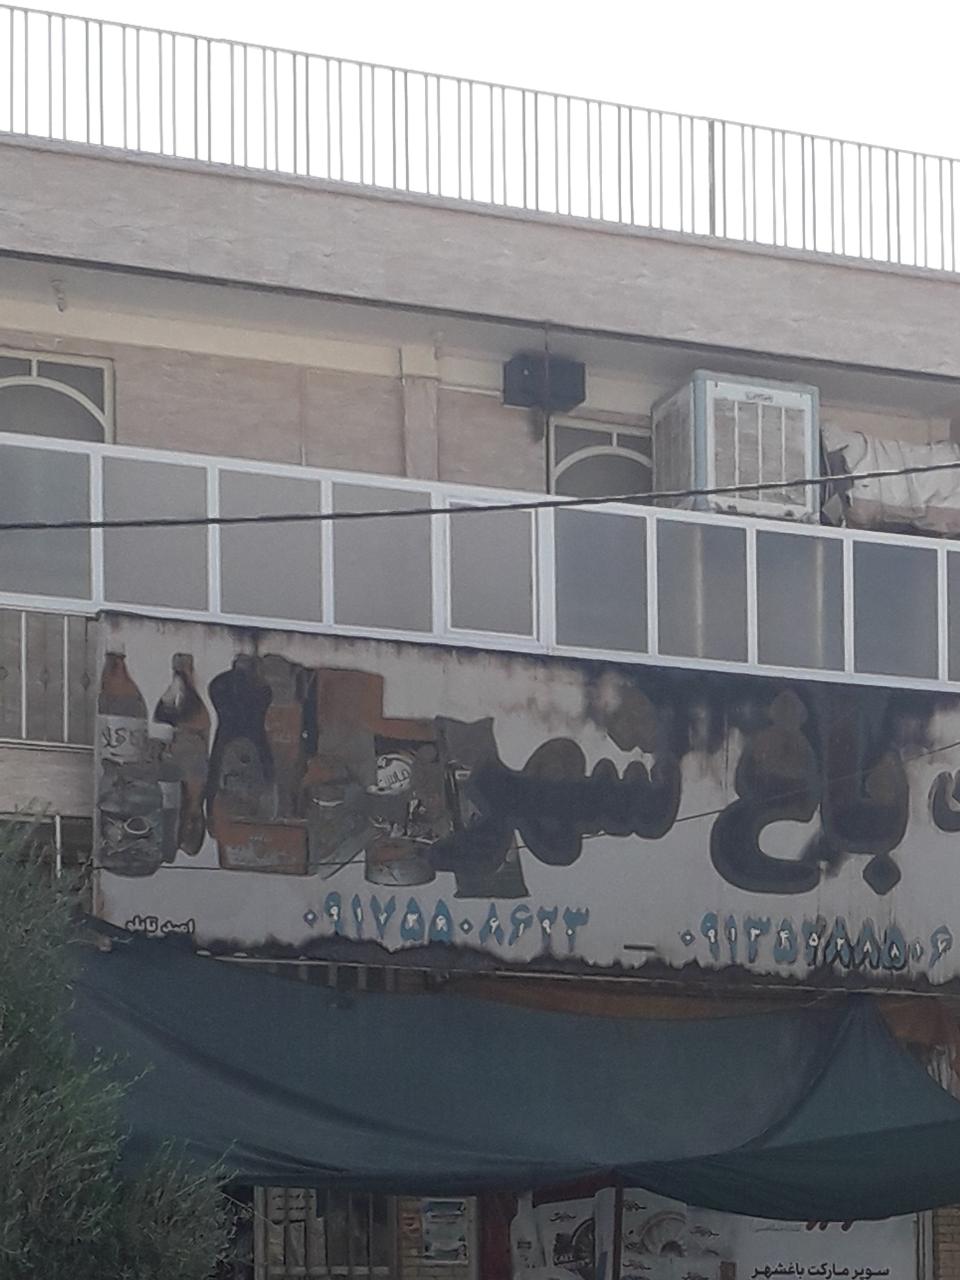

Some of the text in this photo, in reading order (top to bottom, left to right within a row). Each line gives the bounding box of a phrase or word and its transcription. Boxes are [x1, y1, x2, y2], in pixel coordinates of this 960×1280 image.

[751, 1262, 890, 1280] سوپر مارکت باغشهر
